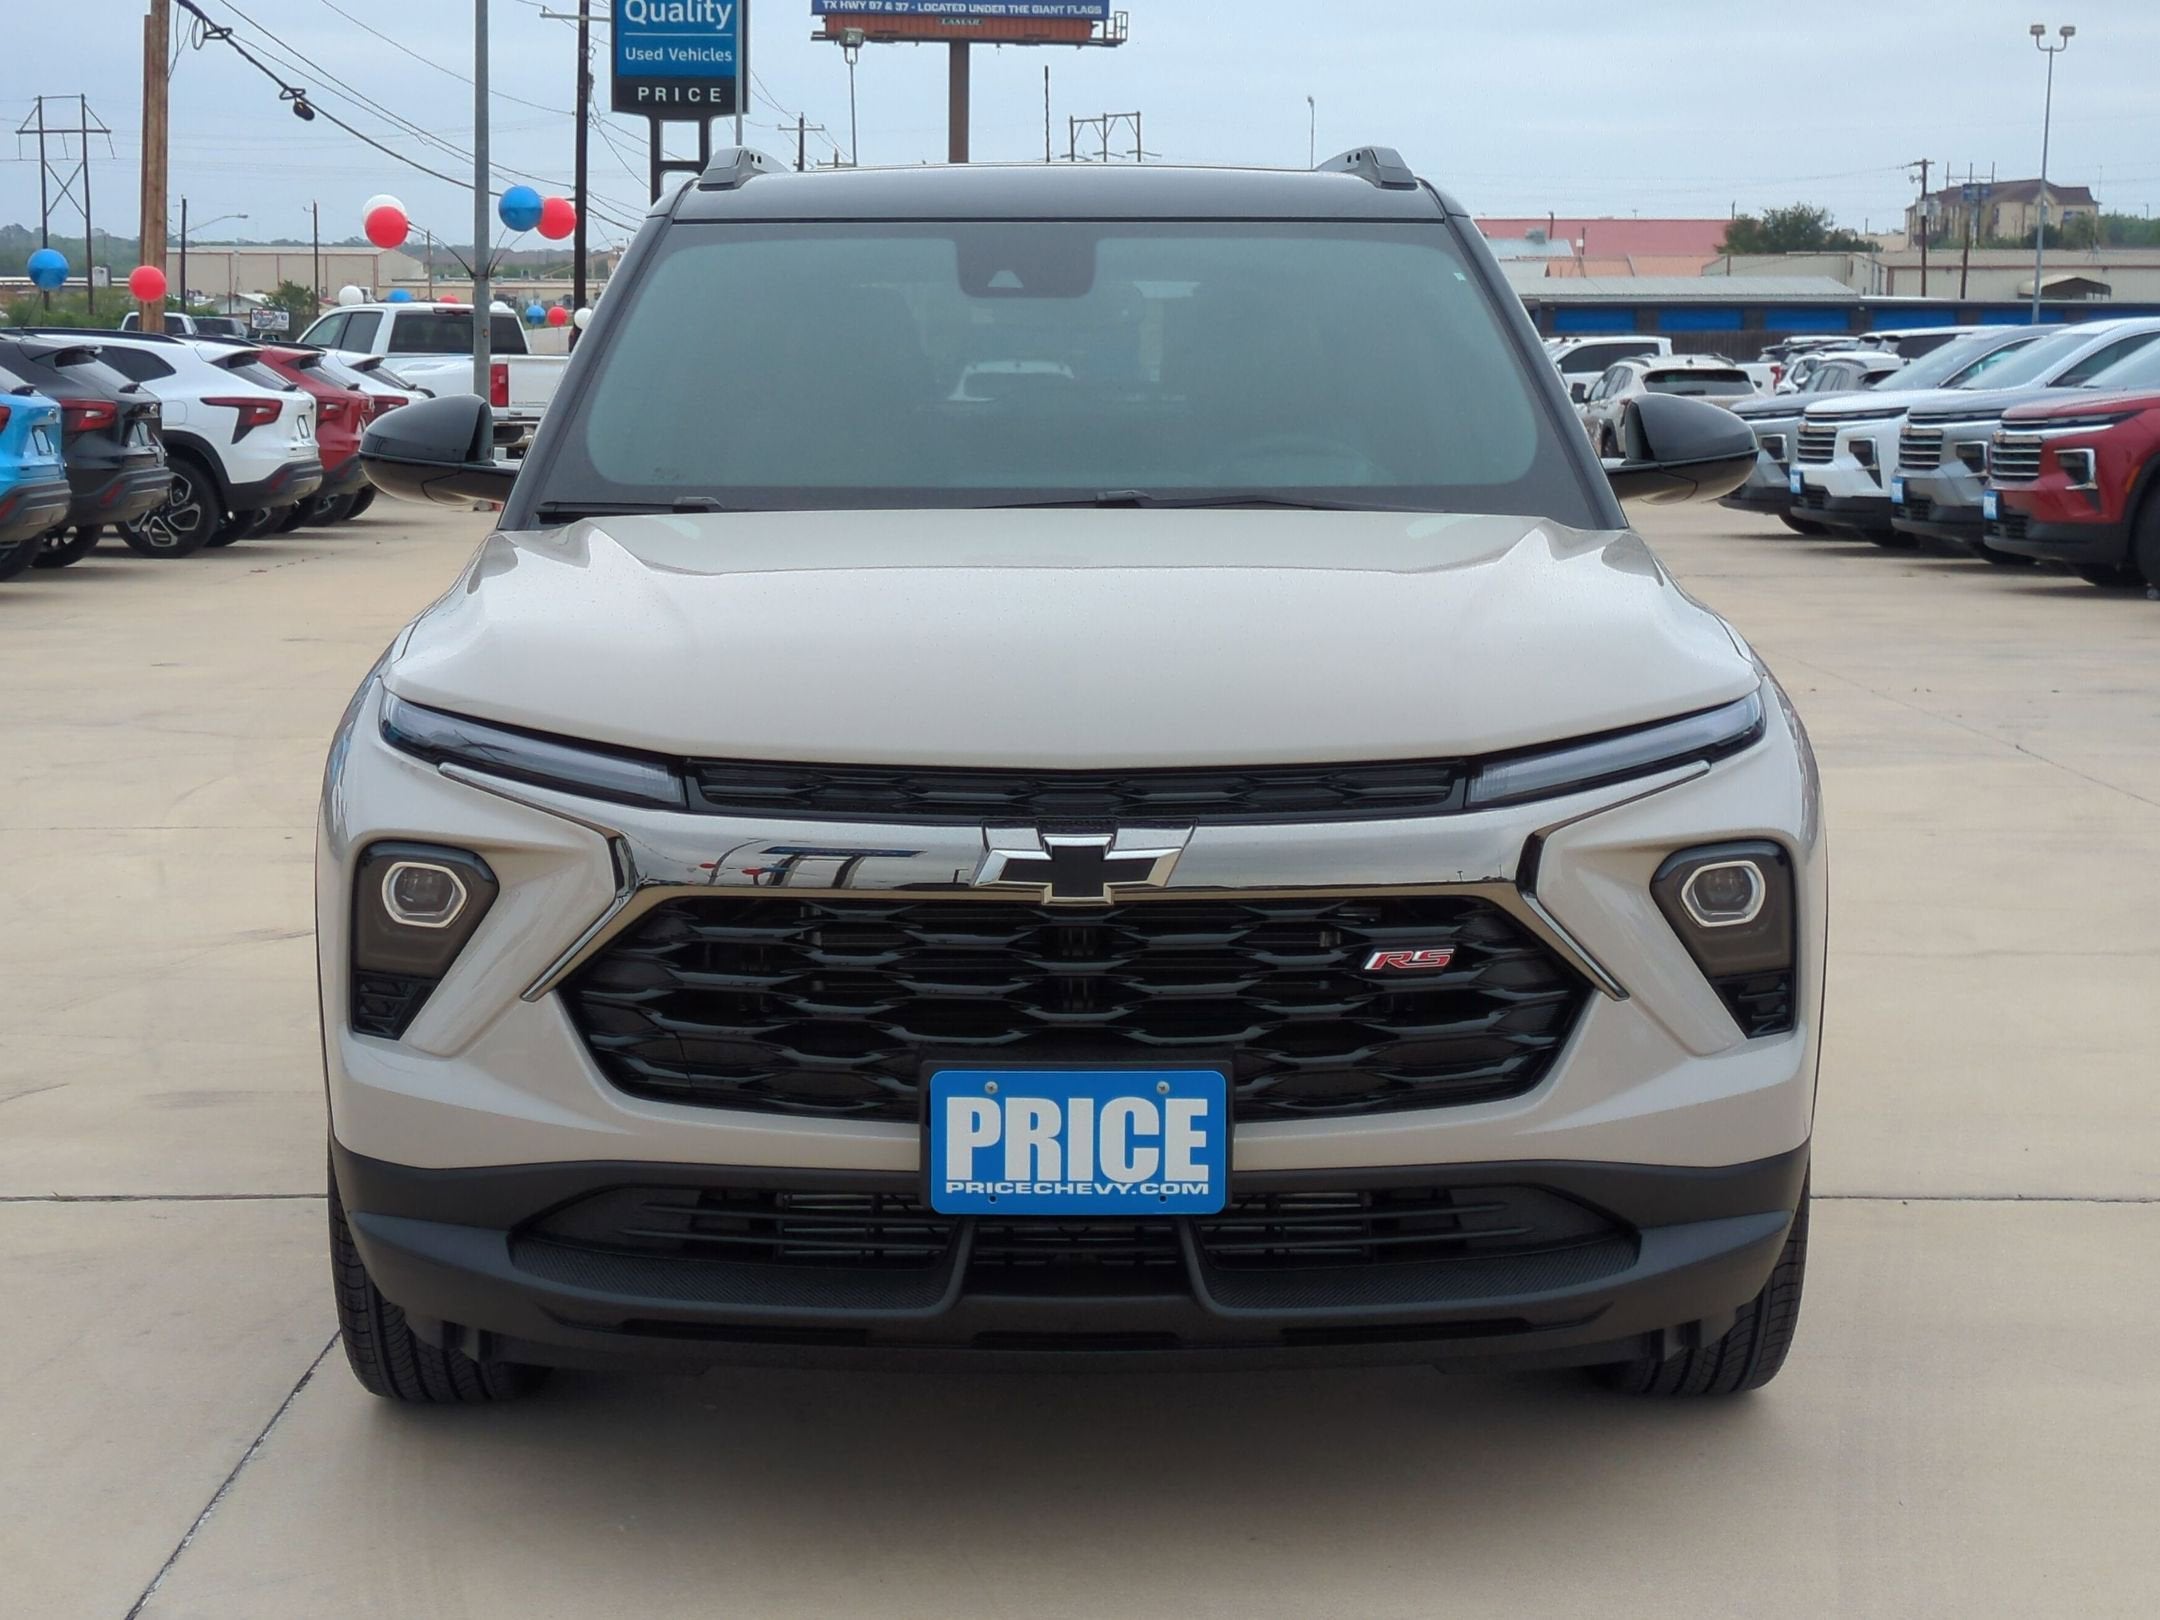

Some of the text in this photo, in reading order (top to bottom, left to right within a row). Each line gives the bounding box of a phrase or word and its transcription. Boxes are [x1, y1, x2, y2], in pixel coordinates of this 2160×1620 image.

[624, 0, 732, 30] Quality
[823, 0, 838, 10] TX
[840, 0, 866, 10] HWY
[896, 2, 909, 11] 37
[918, 3, 966, 12] LOCATED
[969, 3, 1006, 13] UNDER
[1008, 5, 1030, 14] THE
[1032, 5, 1065, 14] GIANT
[1067, 5, 1103, 14] FLAGS
[625, 47, 733, 62] Used Vehicles
[637, 86, 722, 102] PRICE
[1363, 948, 1455, 971] RS
[946, 1096, 1209, 1183] PRICE
[945, 1182, 1209, 1195] PRICECHEVY.COM
